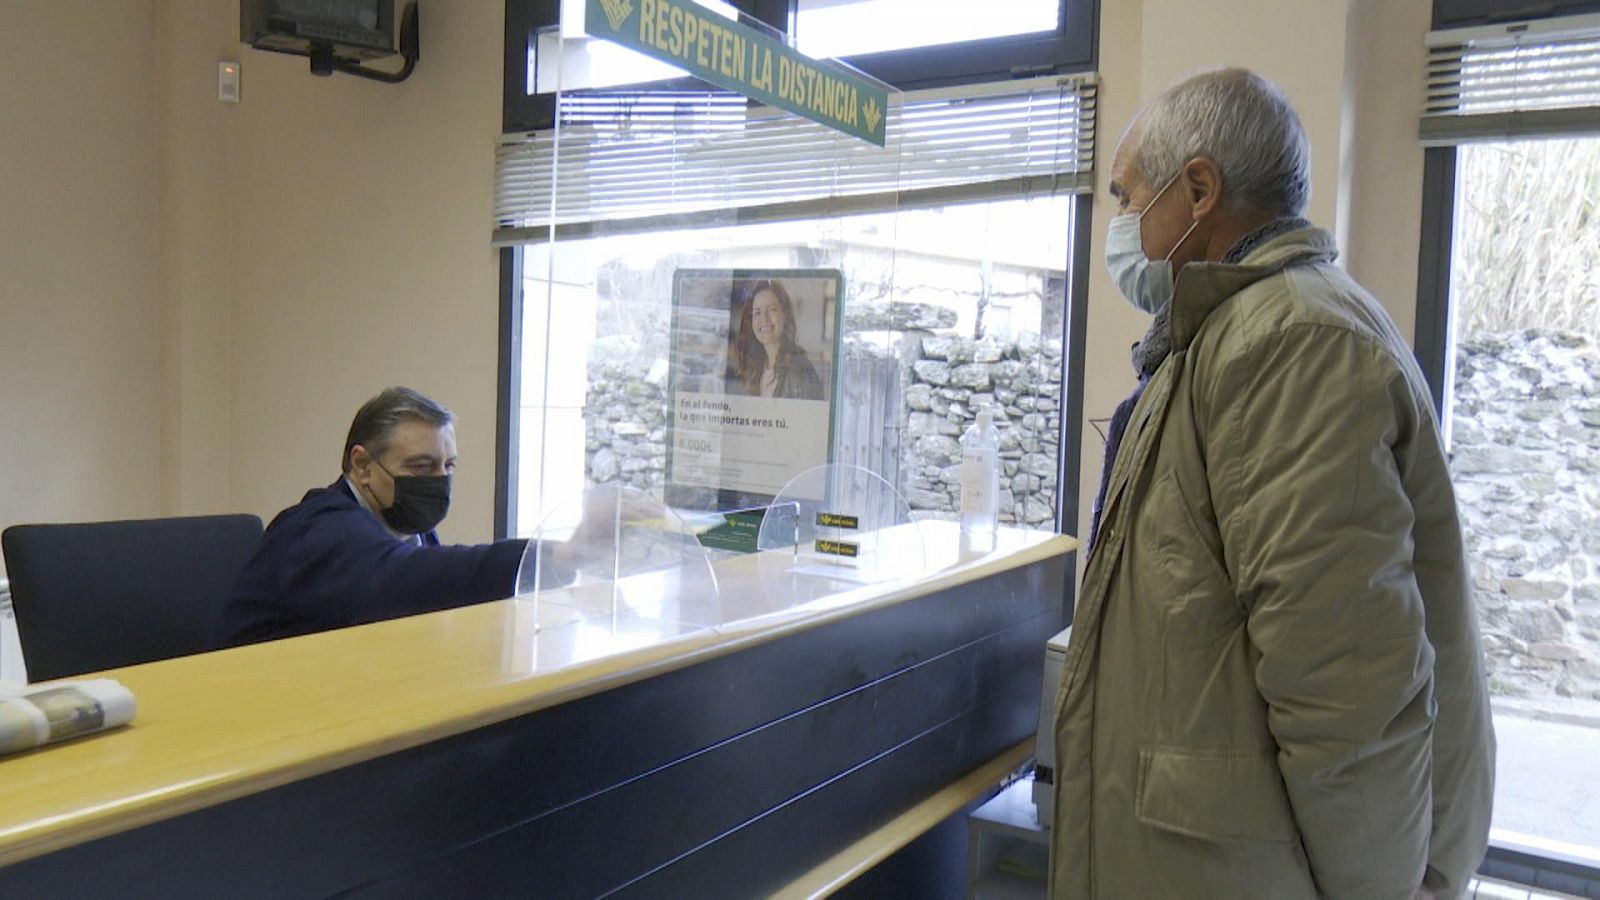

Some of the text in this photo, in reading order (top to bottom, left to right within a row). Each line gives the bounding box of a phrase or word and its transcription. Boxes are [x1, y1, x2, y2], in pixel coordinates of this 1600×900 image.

[640, 0, 858, 127] RESPETEN LA DISTANCIA
[708, 413, 750, 426] importas
[752, 418, 773, 428] eres
